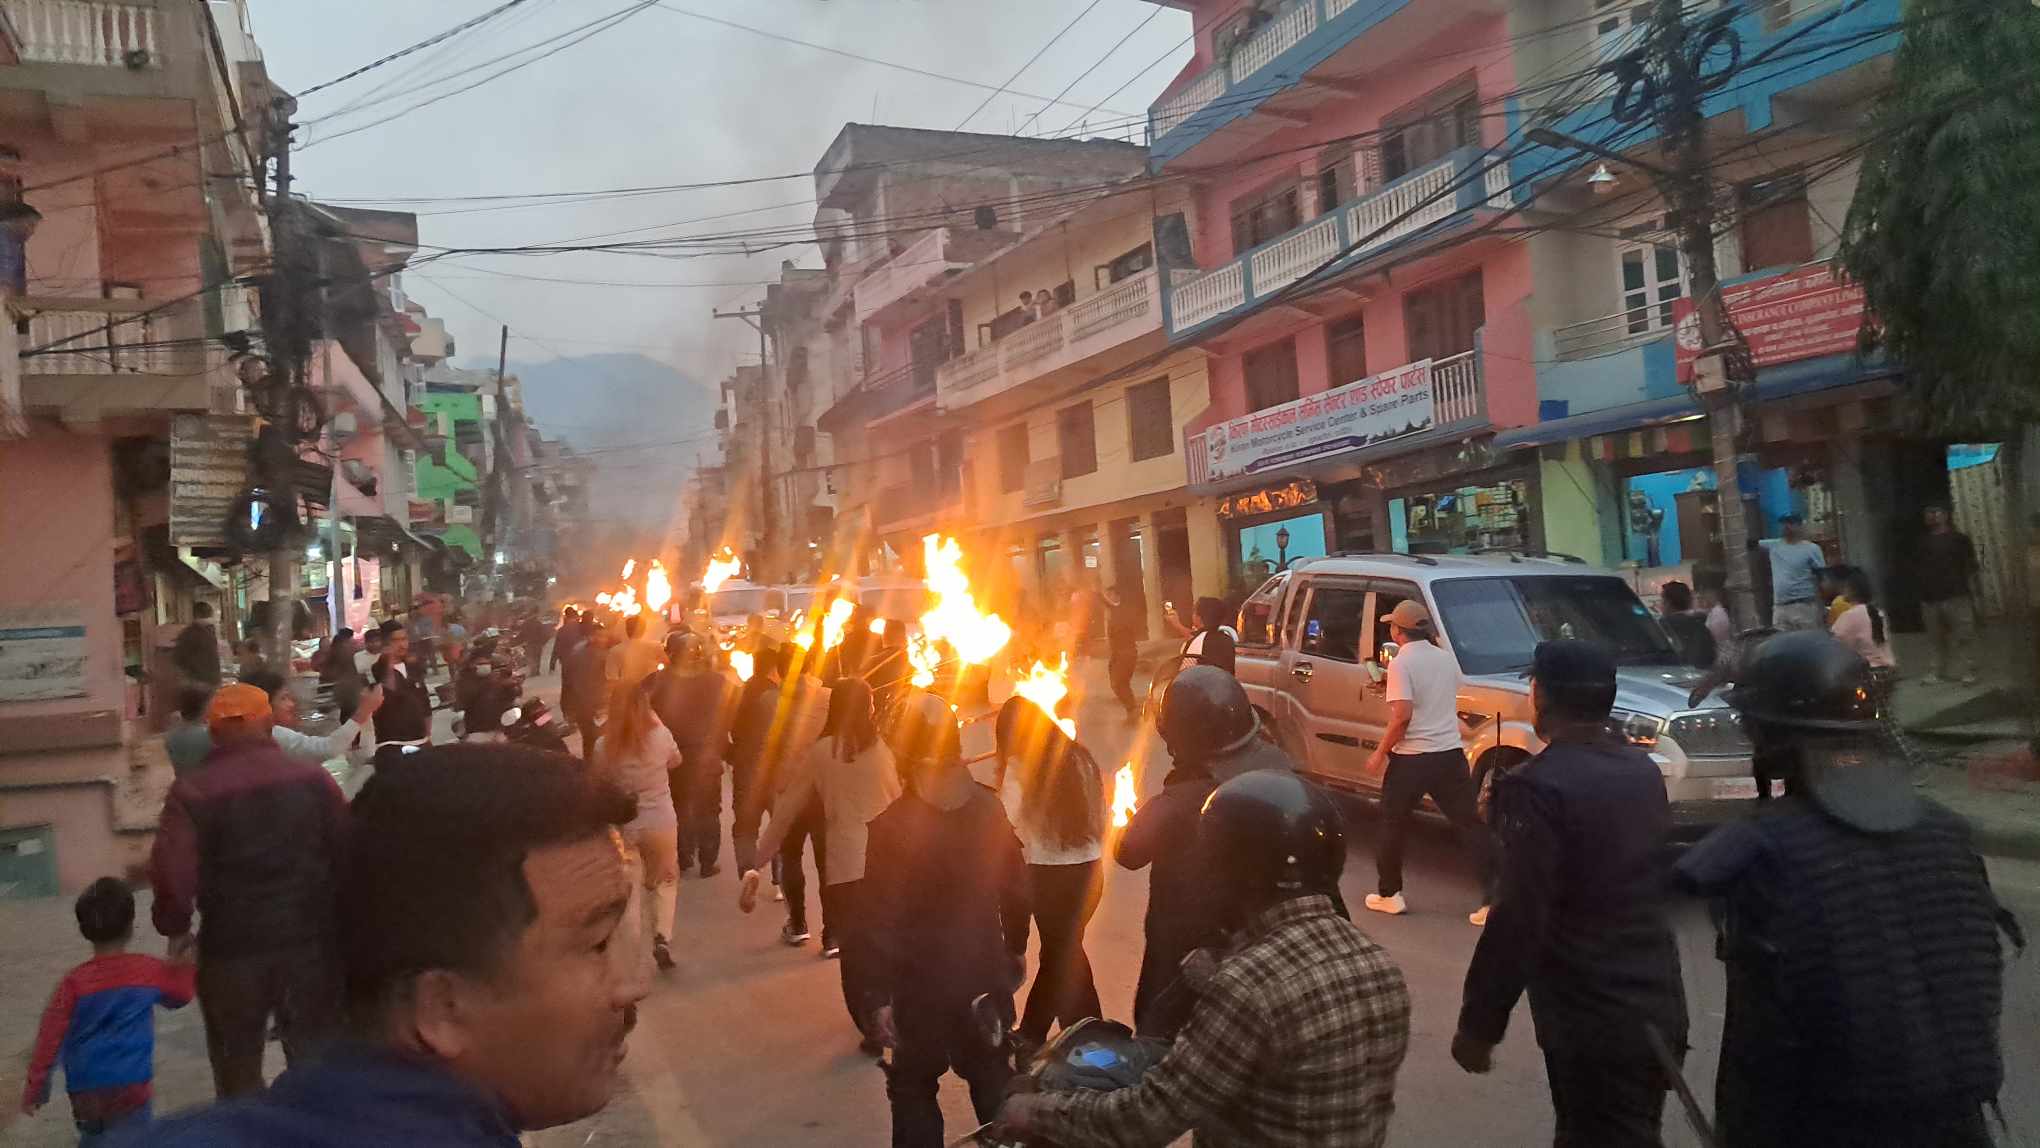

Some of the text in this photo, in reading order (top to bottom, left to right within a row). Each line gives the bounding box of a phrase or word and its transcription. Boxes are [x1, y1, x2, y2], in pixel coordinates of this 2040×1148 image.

[1296, 420, 1325, 436] Service
[1328, 411, 1357, 428] Center
[1360, 407, 1367, 418] &
[1370, 399, 1398, 416] Spare
[1400, 390, 1429, 406] Parts
